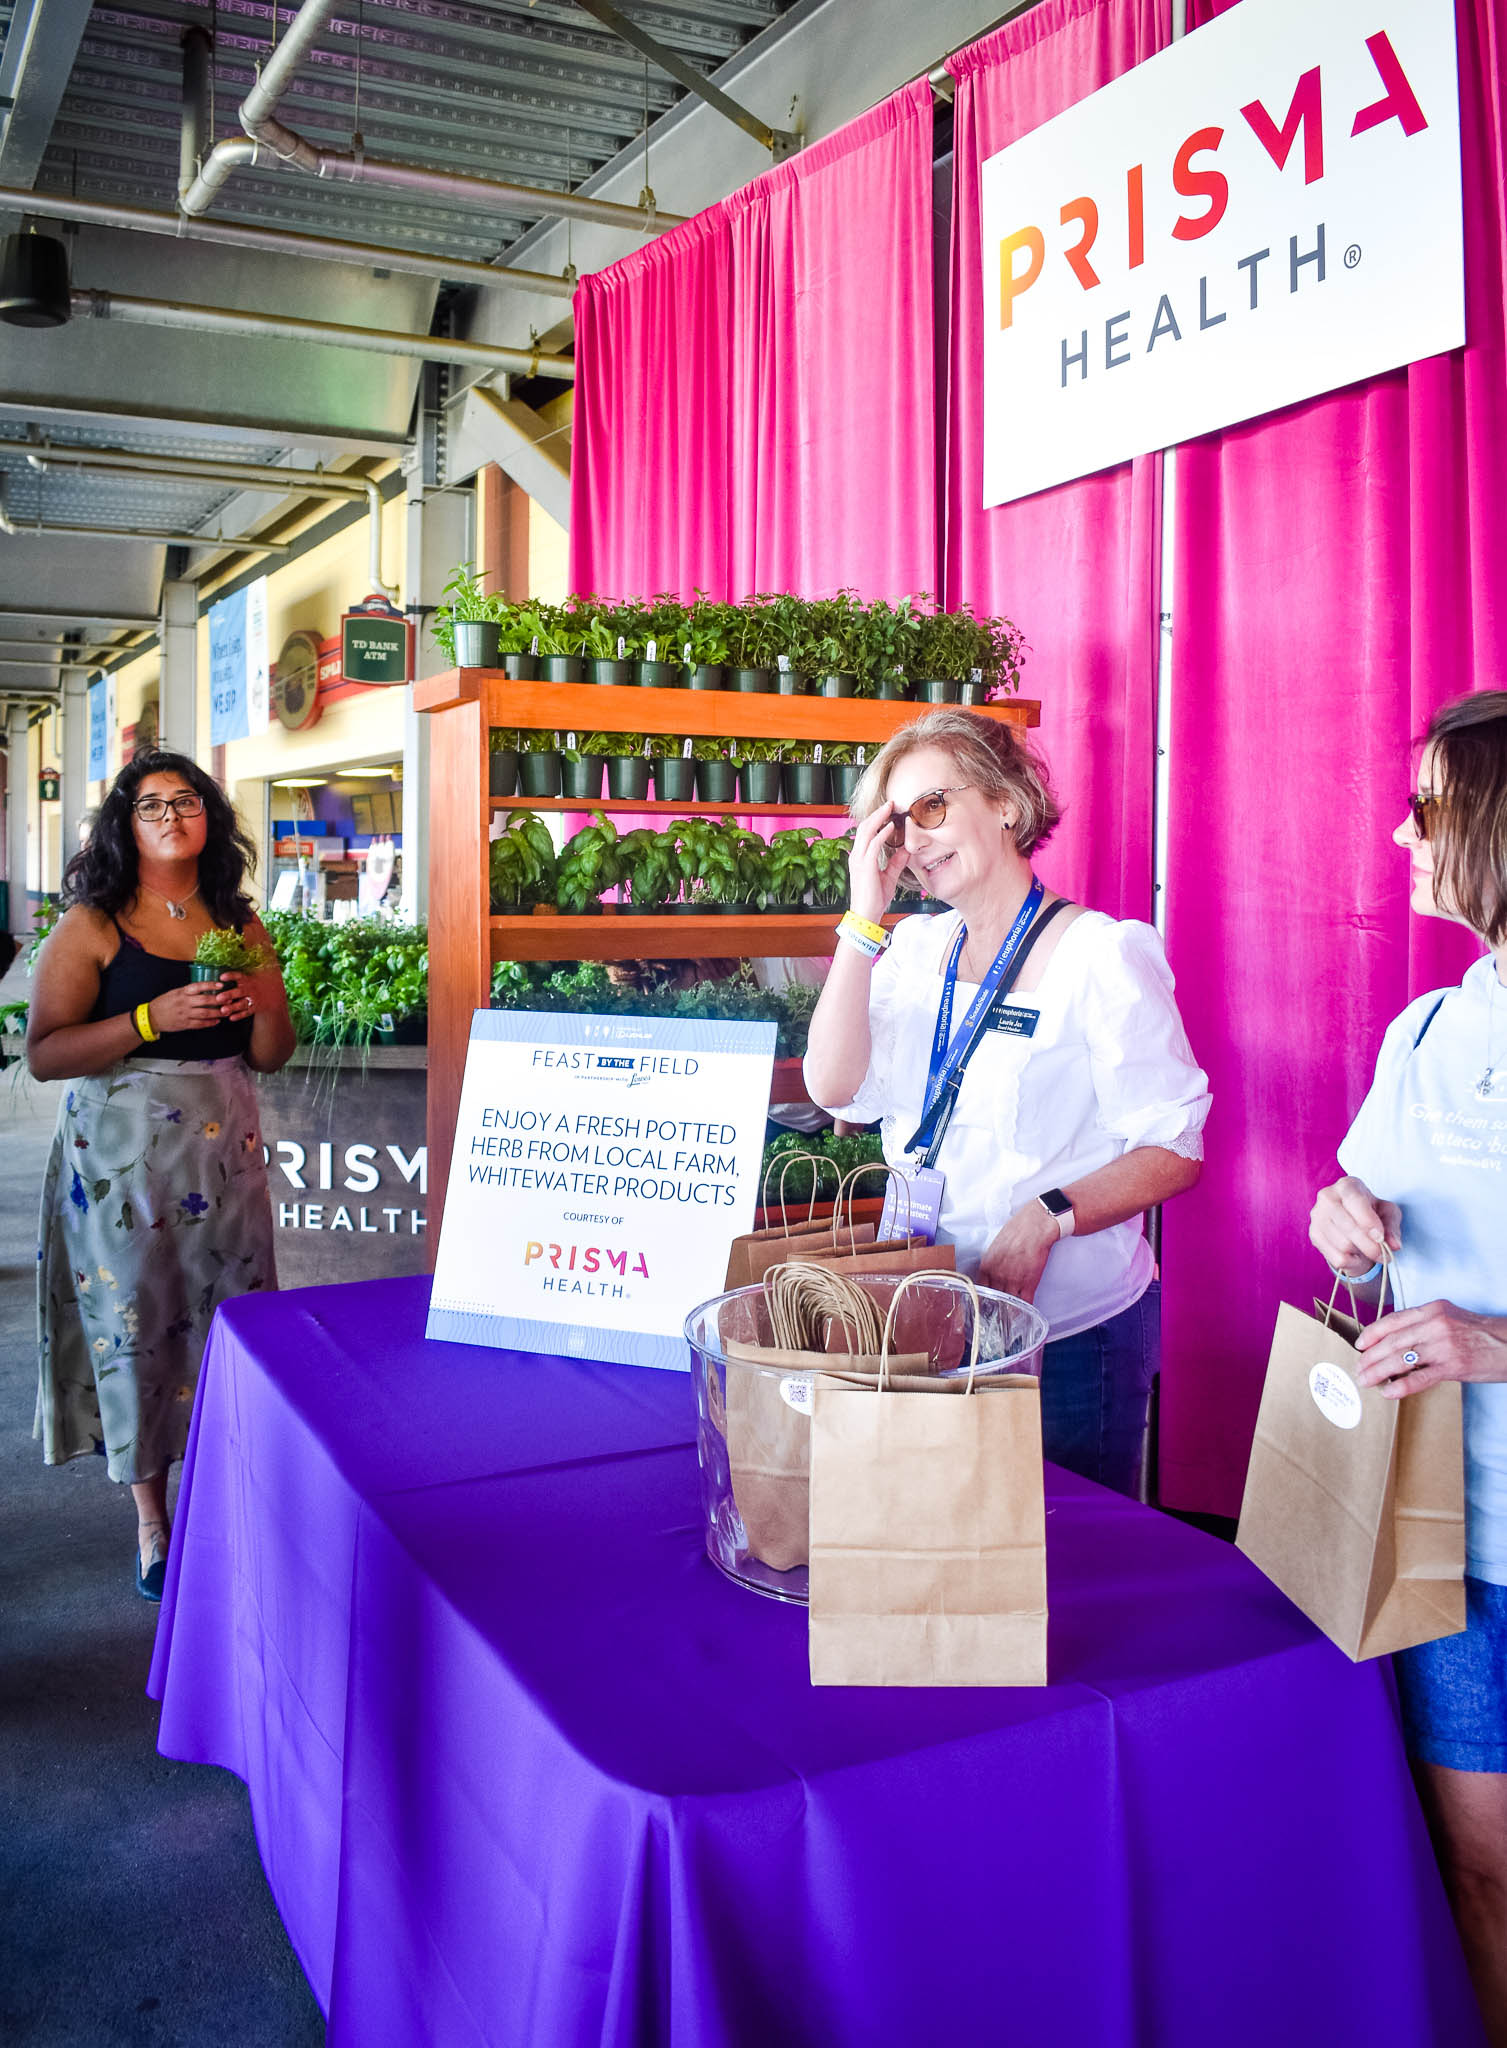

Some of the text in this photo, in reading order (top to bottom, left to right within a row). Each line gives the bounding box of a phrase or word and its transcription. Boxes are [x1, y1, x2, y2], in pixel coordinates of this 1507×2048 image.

[1000, 29, 1429, 331] PRISMA
[1060, 222, 1326, 388] HEALTH
[352, 640, 399, 651] TD BANK
[363, 651, 387, 661] ATM
[1002, 924, 1022, 959] euphoria
[940, 997, 950, 1030] euphoria
[532, 1050, 699, 1076] FEAST BY THE FIELD
[482, 1108, 737, 1145] ENJOY A FRESH POTTED
[263, 1140, 427, 1195] RISM
[471, 1136, 739, 1178] HERB FROM LOCAL FARM,
[468, 1164, 736, 1206] WHITEWATER PRODUCTS
[563, 1211, 624, 1225] COURTESY OF
[887, 1204, 904, 1214] tate
[904, 1198, 933, 1213] utimate
[524, 1240, 650, 1279] PRISMA
[543, 1276, 624, 1299] HEALTH
